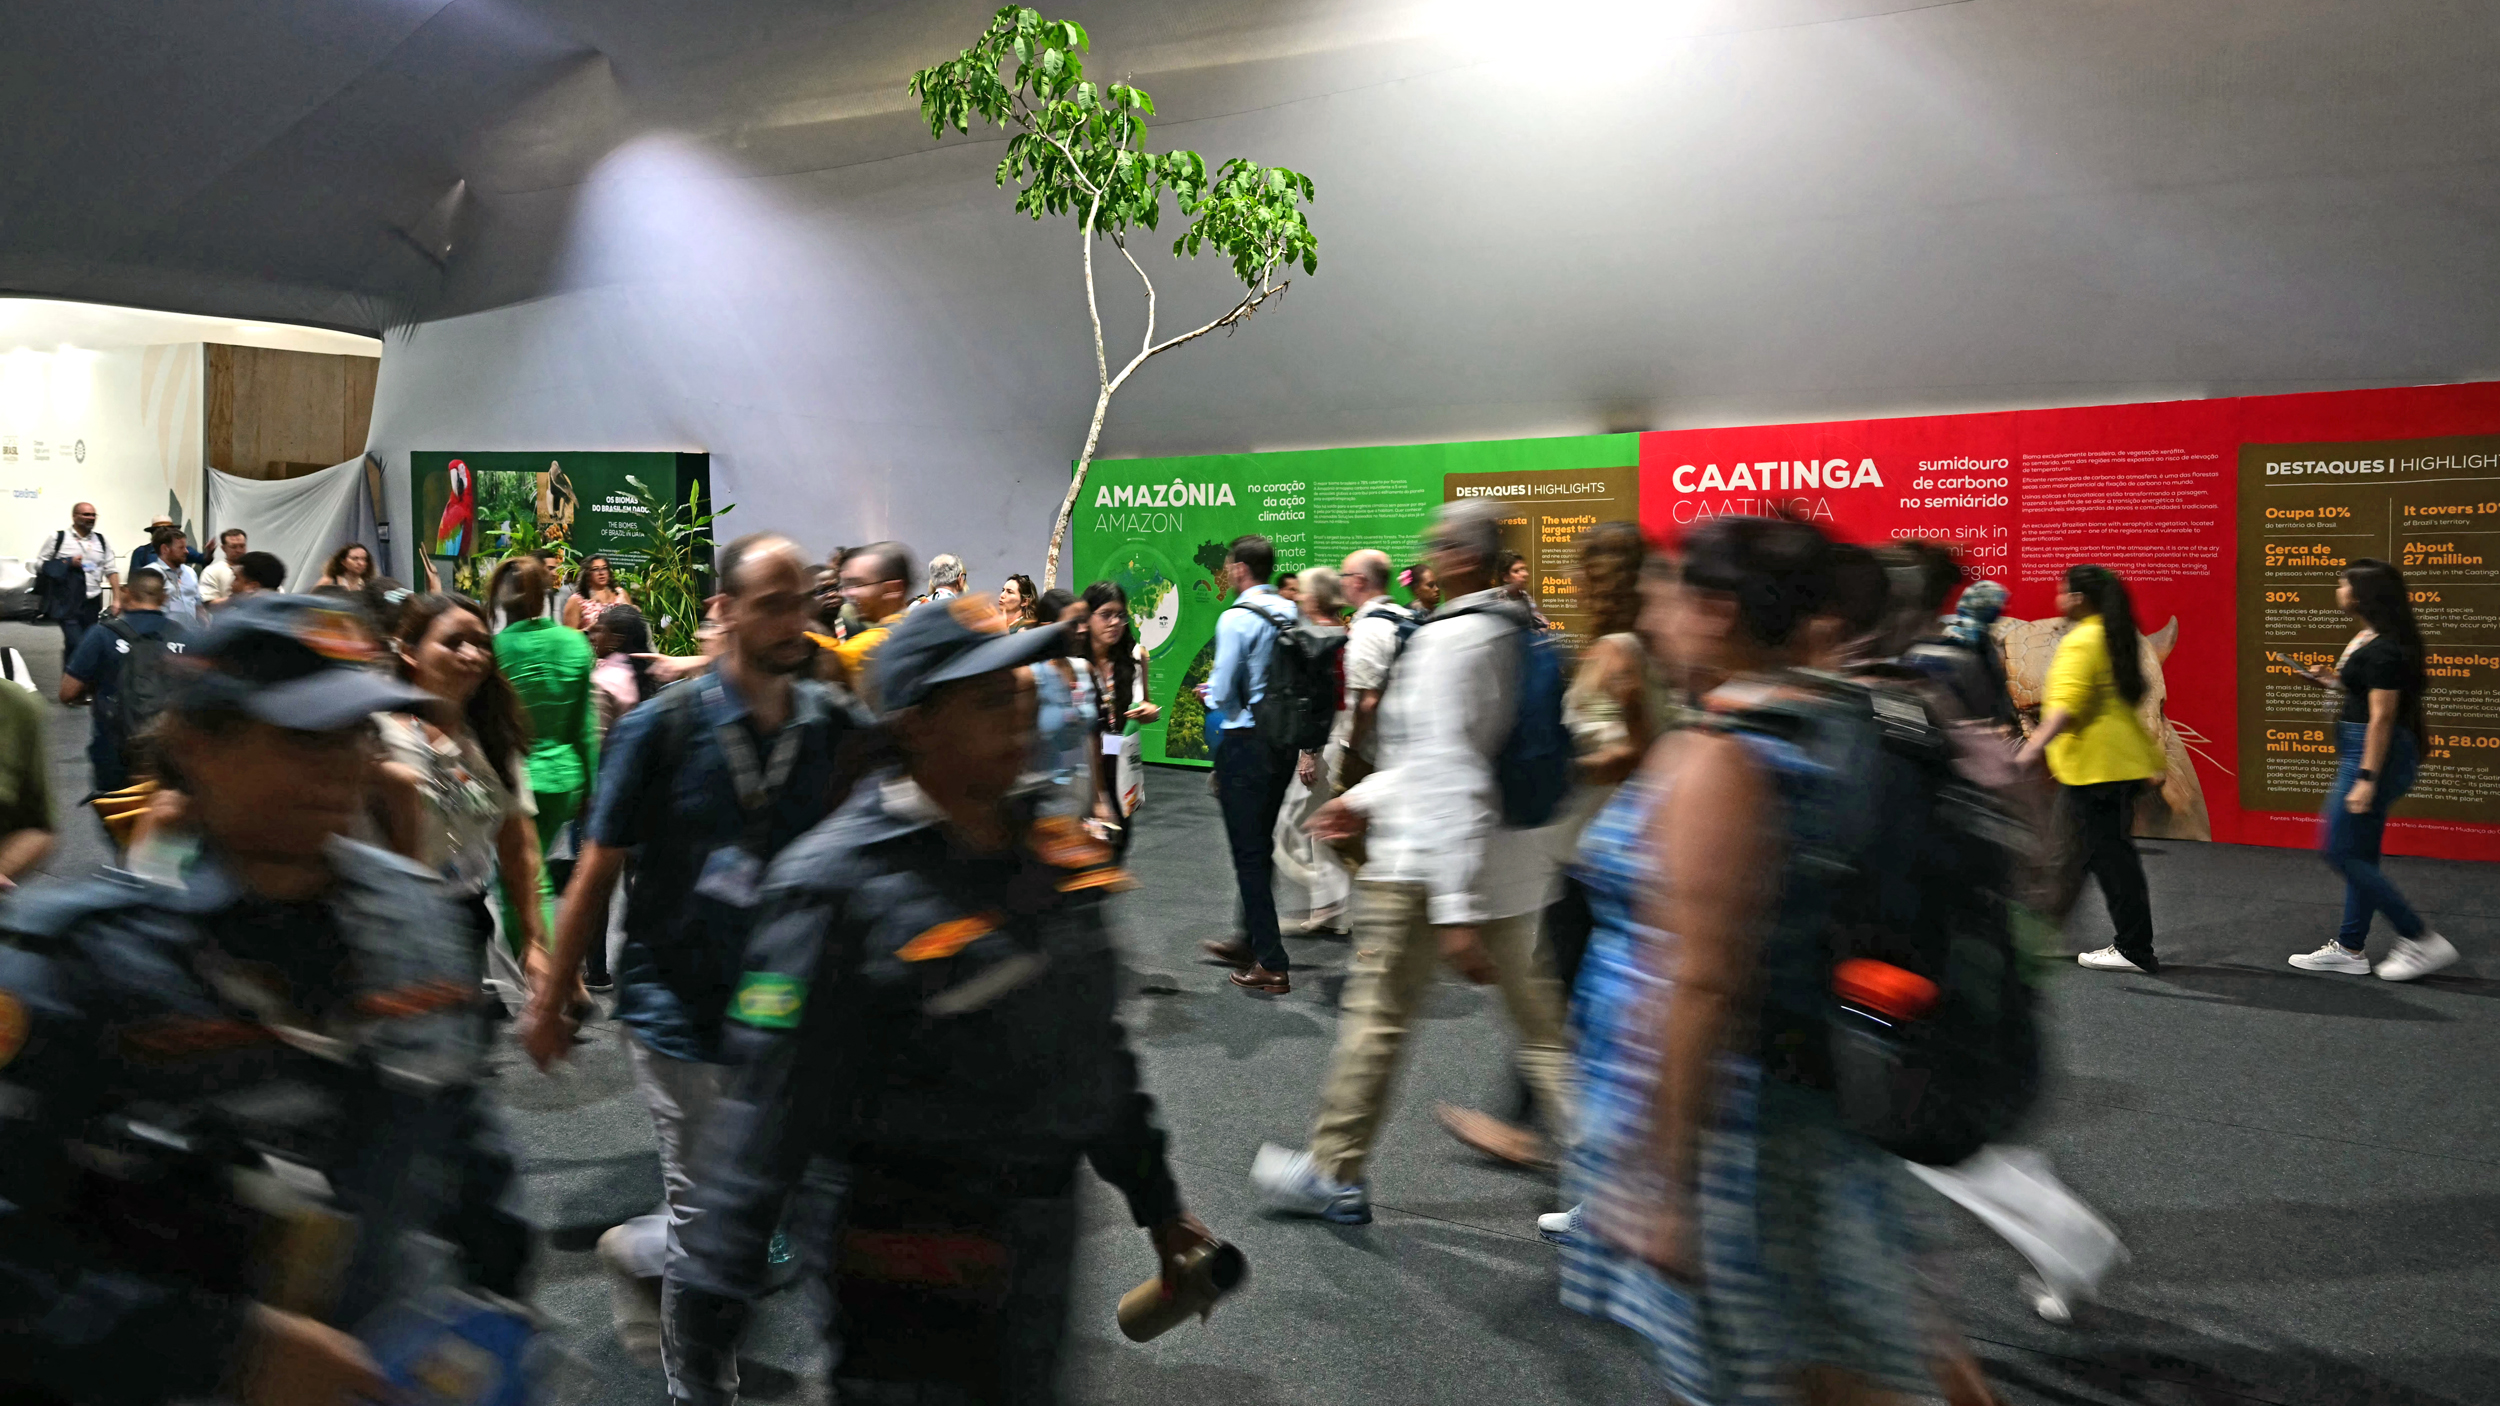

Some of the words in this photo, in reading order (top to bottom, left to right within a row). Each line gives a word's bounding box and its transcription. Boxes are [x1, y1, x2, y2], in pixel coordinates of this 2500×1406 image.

[1919, 457, 2008, 470] sumidouro
[2267, 461, 2384, 474] DESTAQUES
[2401, 455, 2500, 470] HIGHLIGH
[1672, 459, 1884, 494] CAATINGA
[1263, 481, 1305, 494] coração
[1913, 477, 1933, 489] de
[1938, 476, 2008, 488] carbono
[1094, 478, 1236, 507] AMAZÔNIA
[1456, 485, 1526, 496] DESTAQUES
[1535, 483, 1605, 494] HIGHLIGHTS
[1264, 497, 1277, 506] da
[1280, 496, 1305, 508] ação
[1901, 499, 1920, 508] no
[1925, 494, 2008, 507] semiárido
[2266, 508, 2314, 520] Ocupa
[2319, 507, 2350, 517] 10%
[2405, 506, 2416, 515] It
[2420, 506, 2473, 514] covers
[2478, 503, 2500, 513] 10
[1259, 511, 1305, 521] climática
[1561, 515, 1596, 524] world's
[1095, 513, 1182, 532] AMAZON
[1542, 525, 1576, 536] largest
[1891, 526, 1950, 538] carbon
[1956, 525, 1987, 538] sink
[1994, 525, 2007, 537] in
[1276, 533, 1306, 542] heart
[1542, 535, 1571, 543] forest
[1273, 548, 1306, 557] limate
[2265, 544, 2308, 554] Cerca
[2312, 544, 2331, 554] de
[2403, 543, 2454, 552] About
[2266, 556, 2284, 566] 27
[2288, 556, 2346, 566] milhões
[2404, 555, 2424, 565] 27
[2428, 554, 2482, 564] million
[1272, 563, 1306, 573] action
[1964, 563, 2007, 580] egion
[2266, 592, 2299, 602] 30%
[2267, 730, 2299, 739] Com
[2304, 731, 2324, 740] 28
[2267, 742, 2288, 751] mil
[2293, 742, 2335, 753] horas
